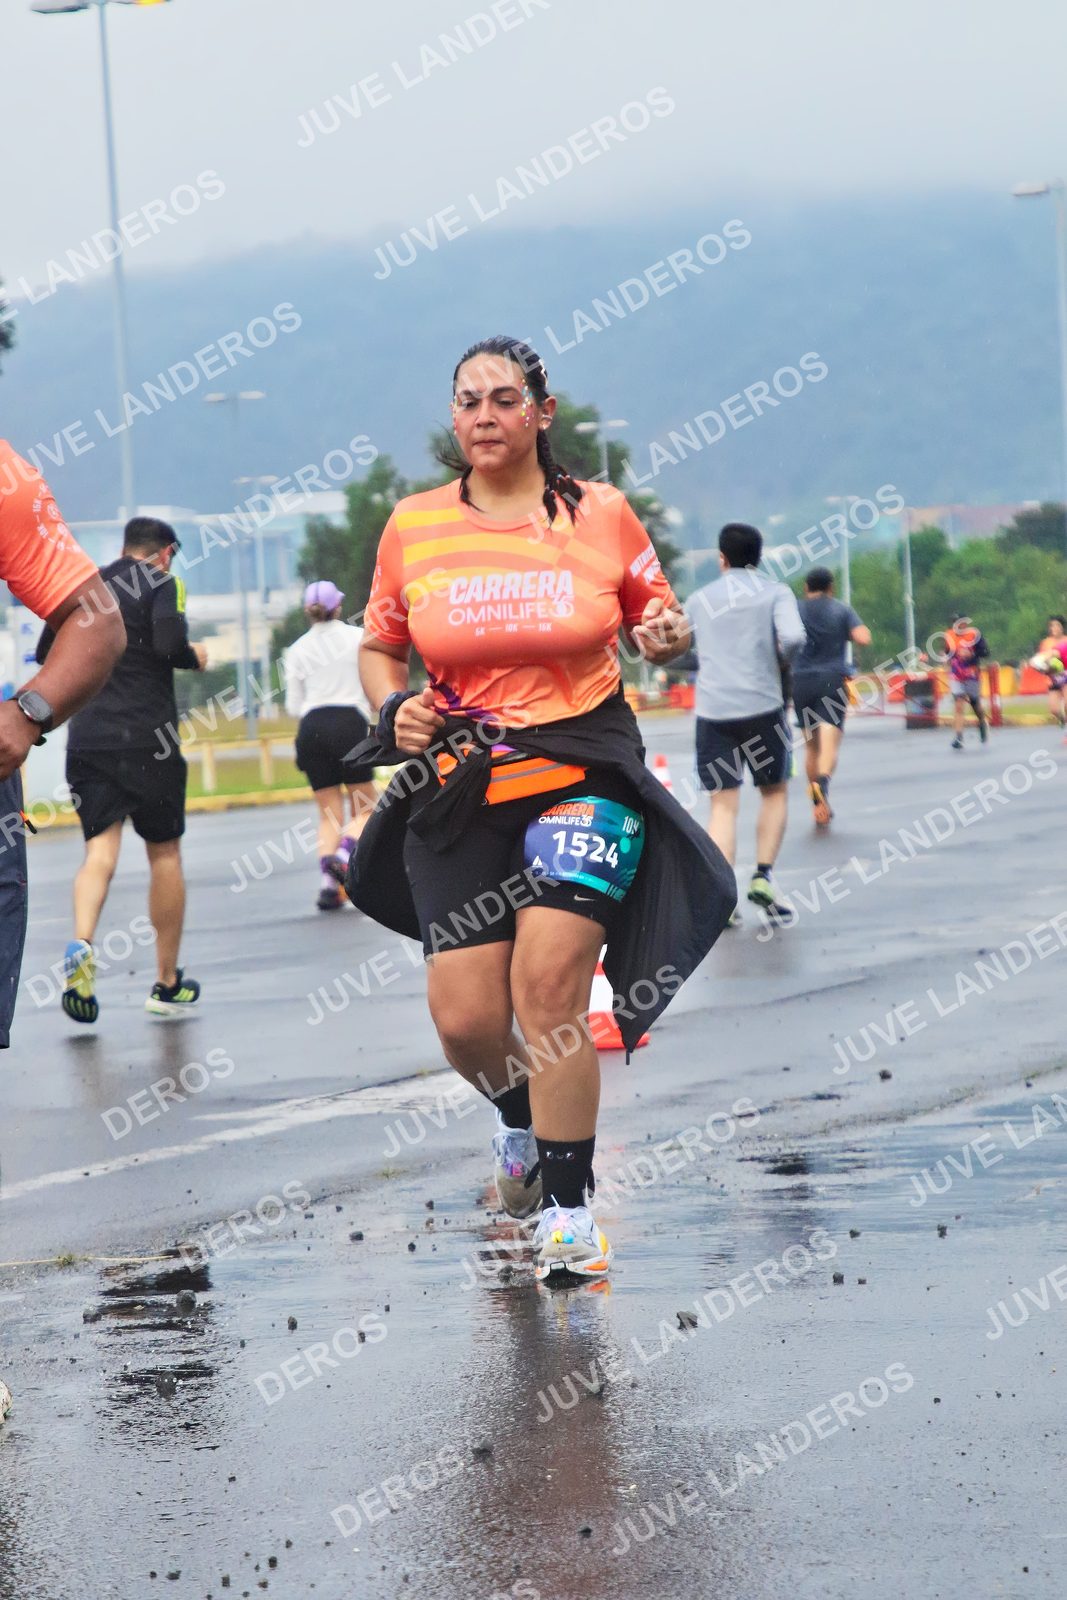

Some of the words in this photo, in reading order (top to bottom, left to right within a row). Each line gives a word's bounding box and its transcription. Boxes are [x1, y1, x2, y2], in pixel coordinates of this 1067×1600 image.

[449, 569, 574, 605] CARRERA
[448, 601, 549, 626] OMNILIFE
[552, 830, 619, 869] 1524
